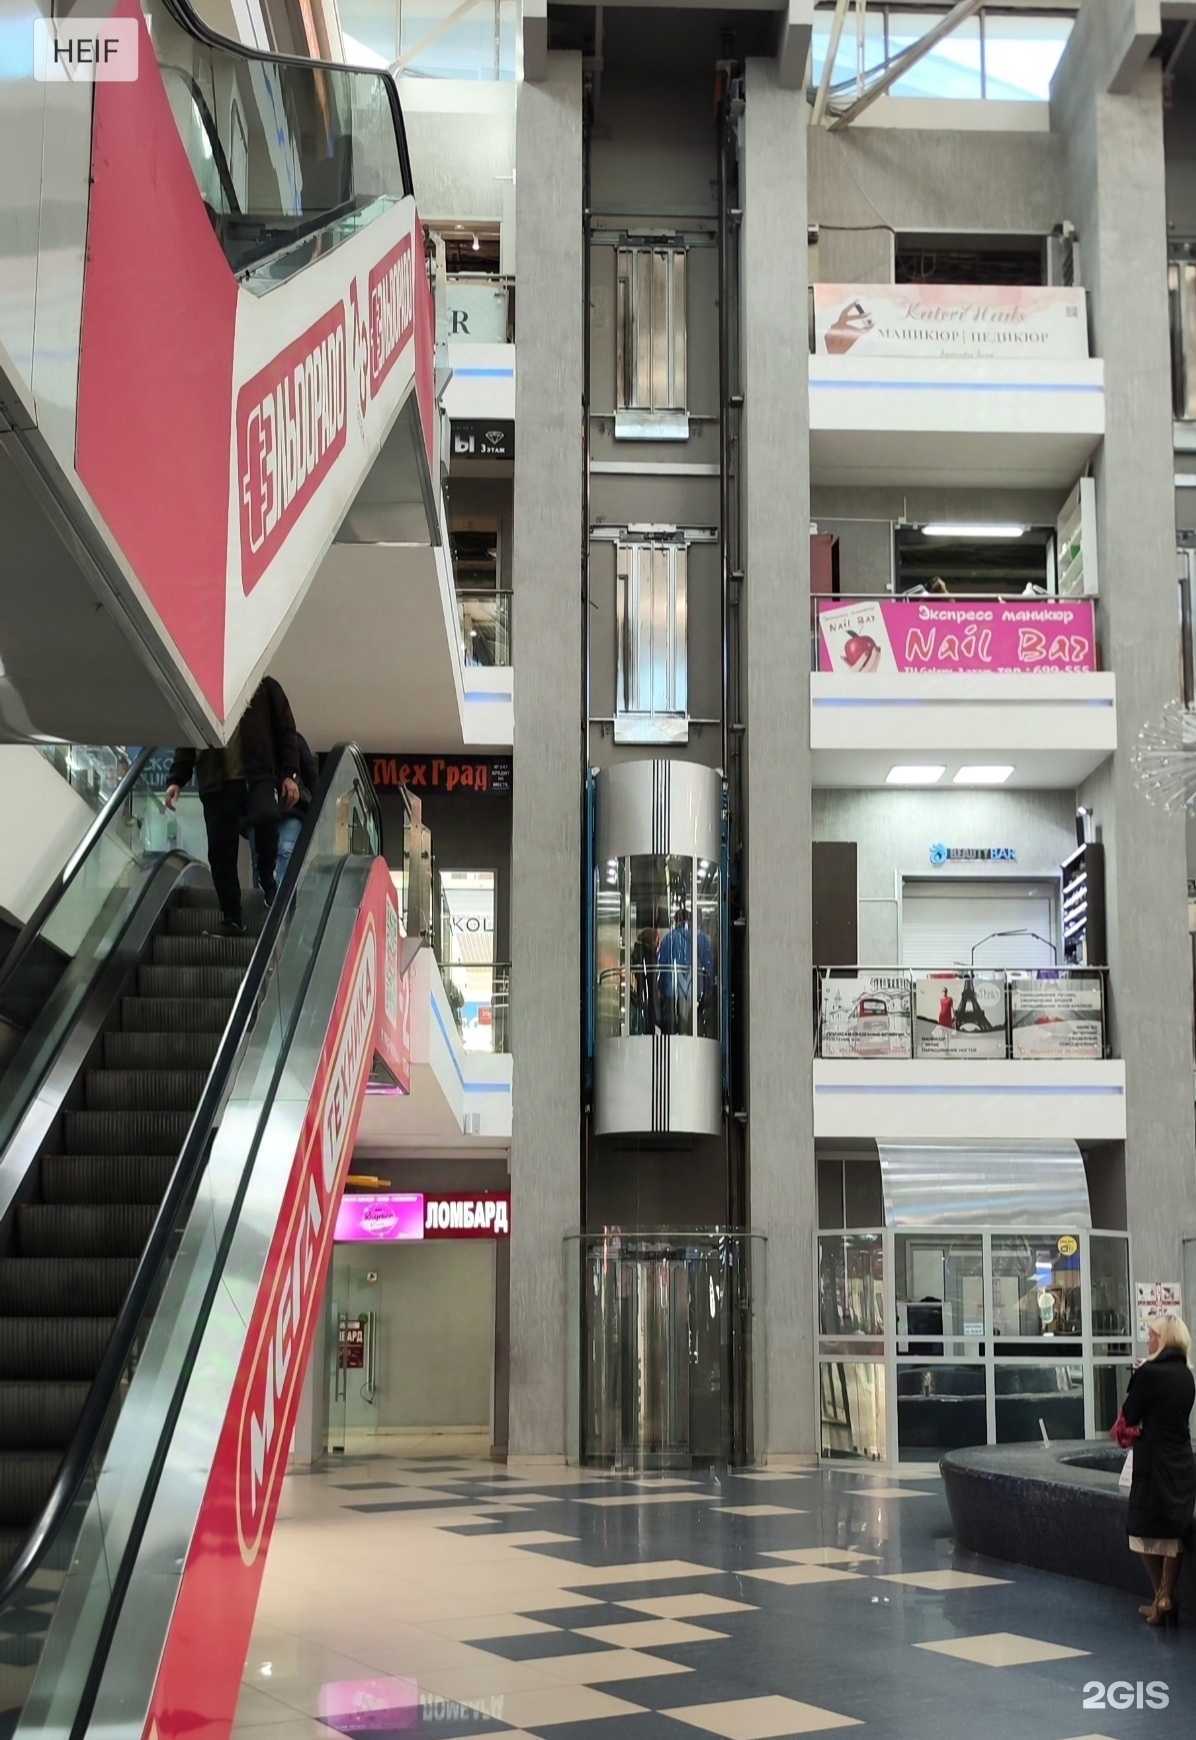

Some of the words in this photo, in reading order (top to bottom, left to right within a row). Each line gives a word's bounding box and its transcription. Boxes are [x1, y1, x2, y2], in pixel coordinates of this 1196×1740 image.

[877, 328, 959, 342] МАНИКЮР
[970, 331, 1050, 344] ПЕДИКЮР
[918, 605, 993, 624] Экспресс
[1002, 609, 1074, 624] маникюр
[425, 1201, 508, 1233] ЛОМБАРД
